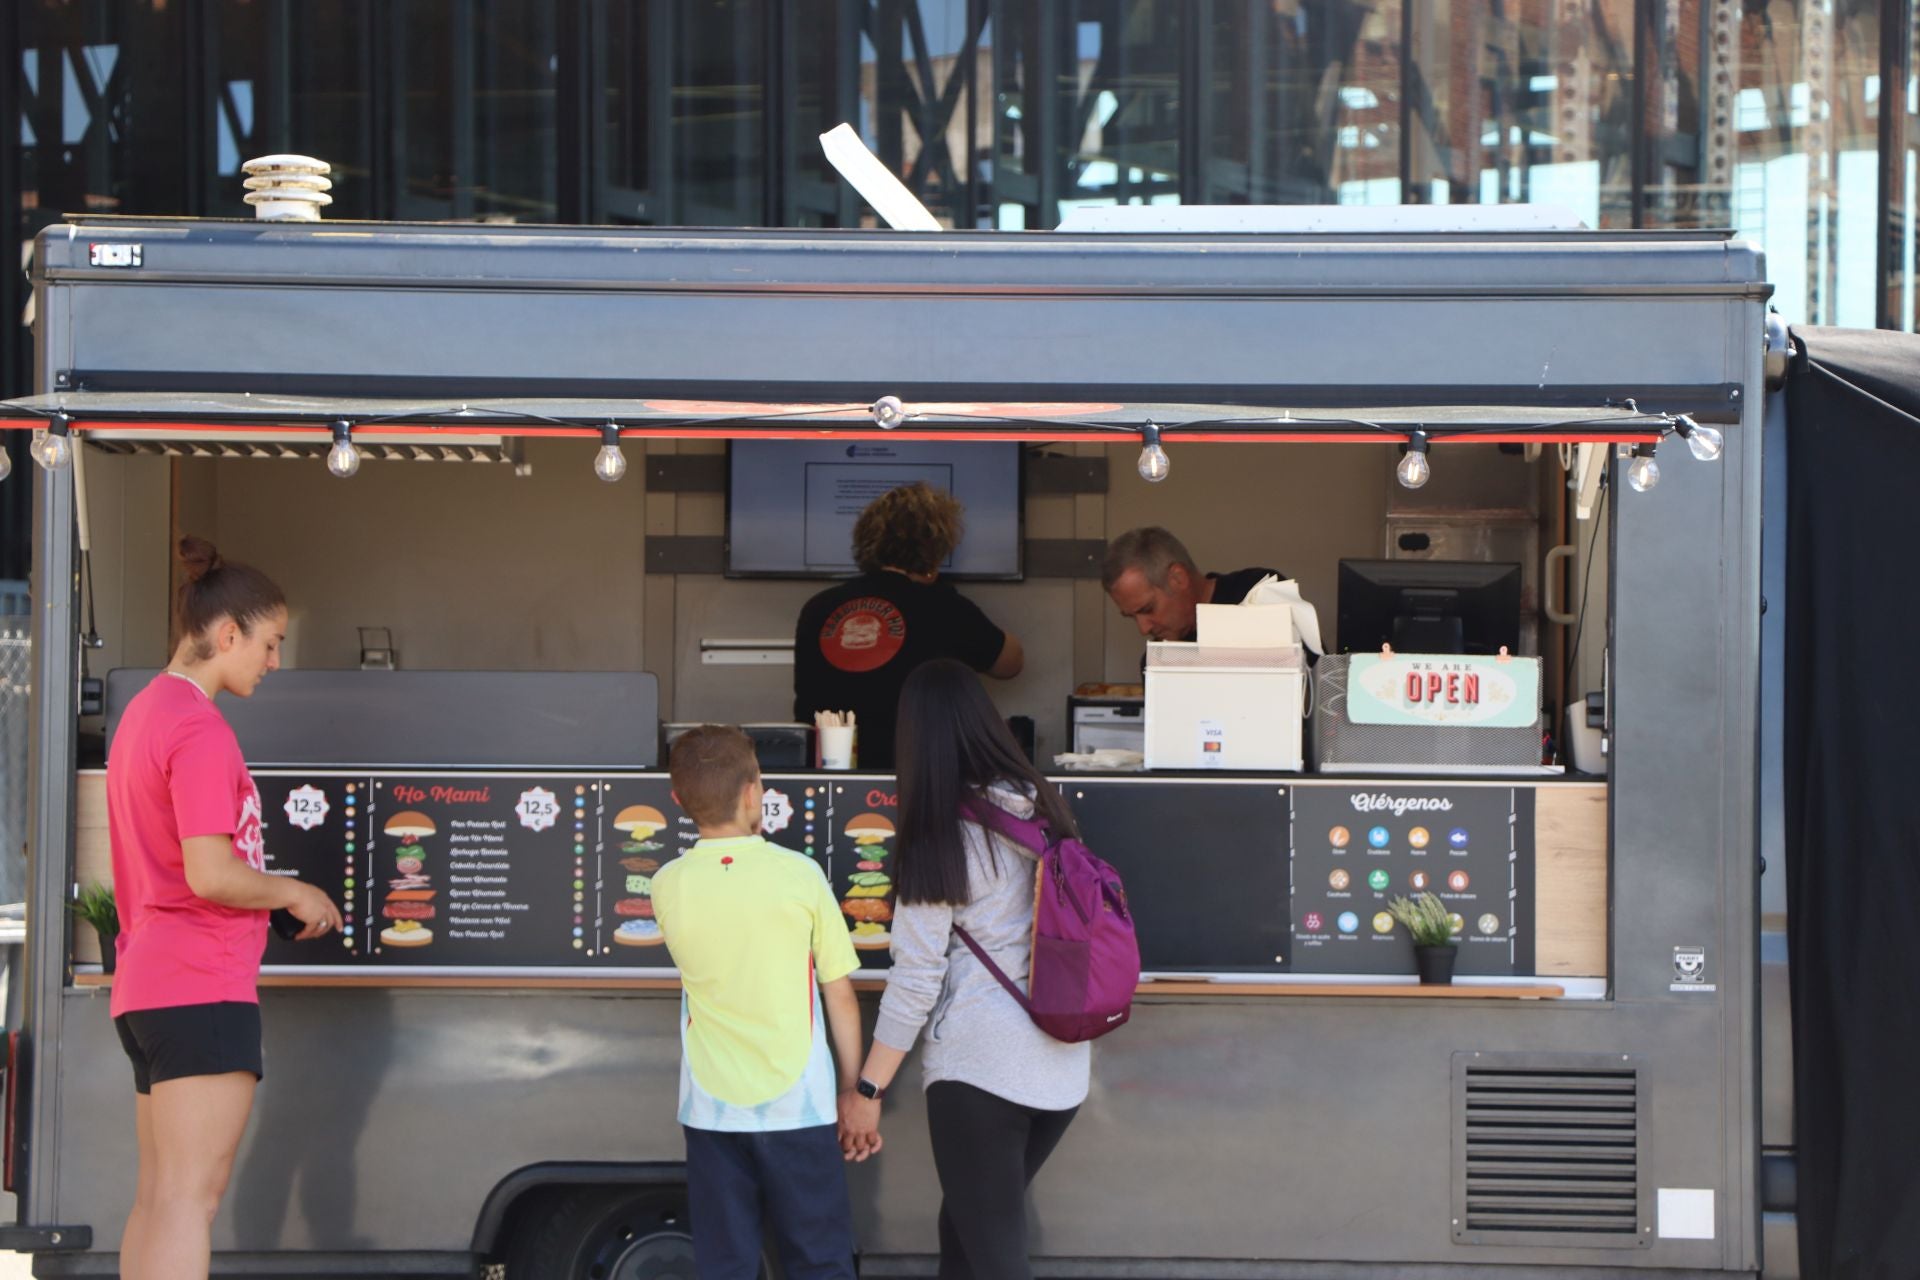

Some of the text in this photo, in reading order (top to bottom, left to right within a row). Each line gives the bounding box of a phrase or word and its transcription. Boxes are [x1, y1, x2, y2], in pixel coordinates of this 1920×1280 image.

[1406, 672, 1479, 704] OPEN
[393, 784, 490, 804] Ho Mami
[292, 799, 322, 814] 12,5
[523, 800, 553, 815] 12,5
[762, 803, 780, 816] 13
[1350, 792, 1453, 816] Alérgenos
